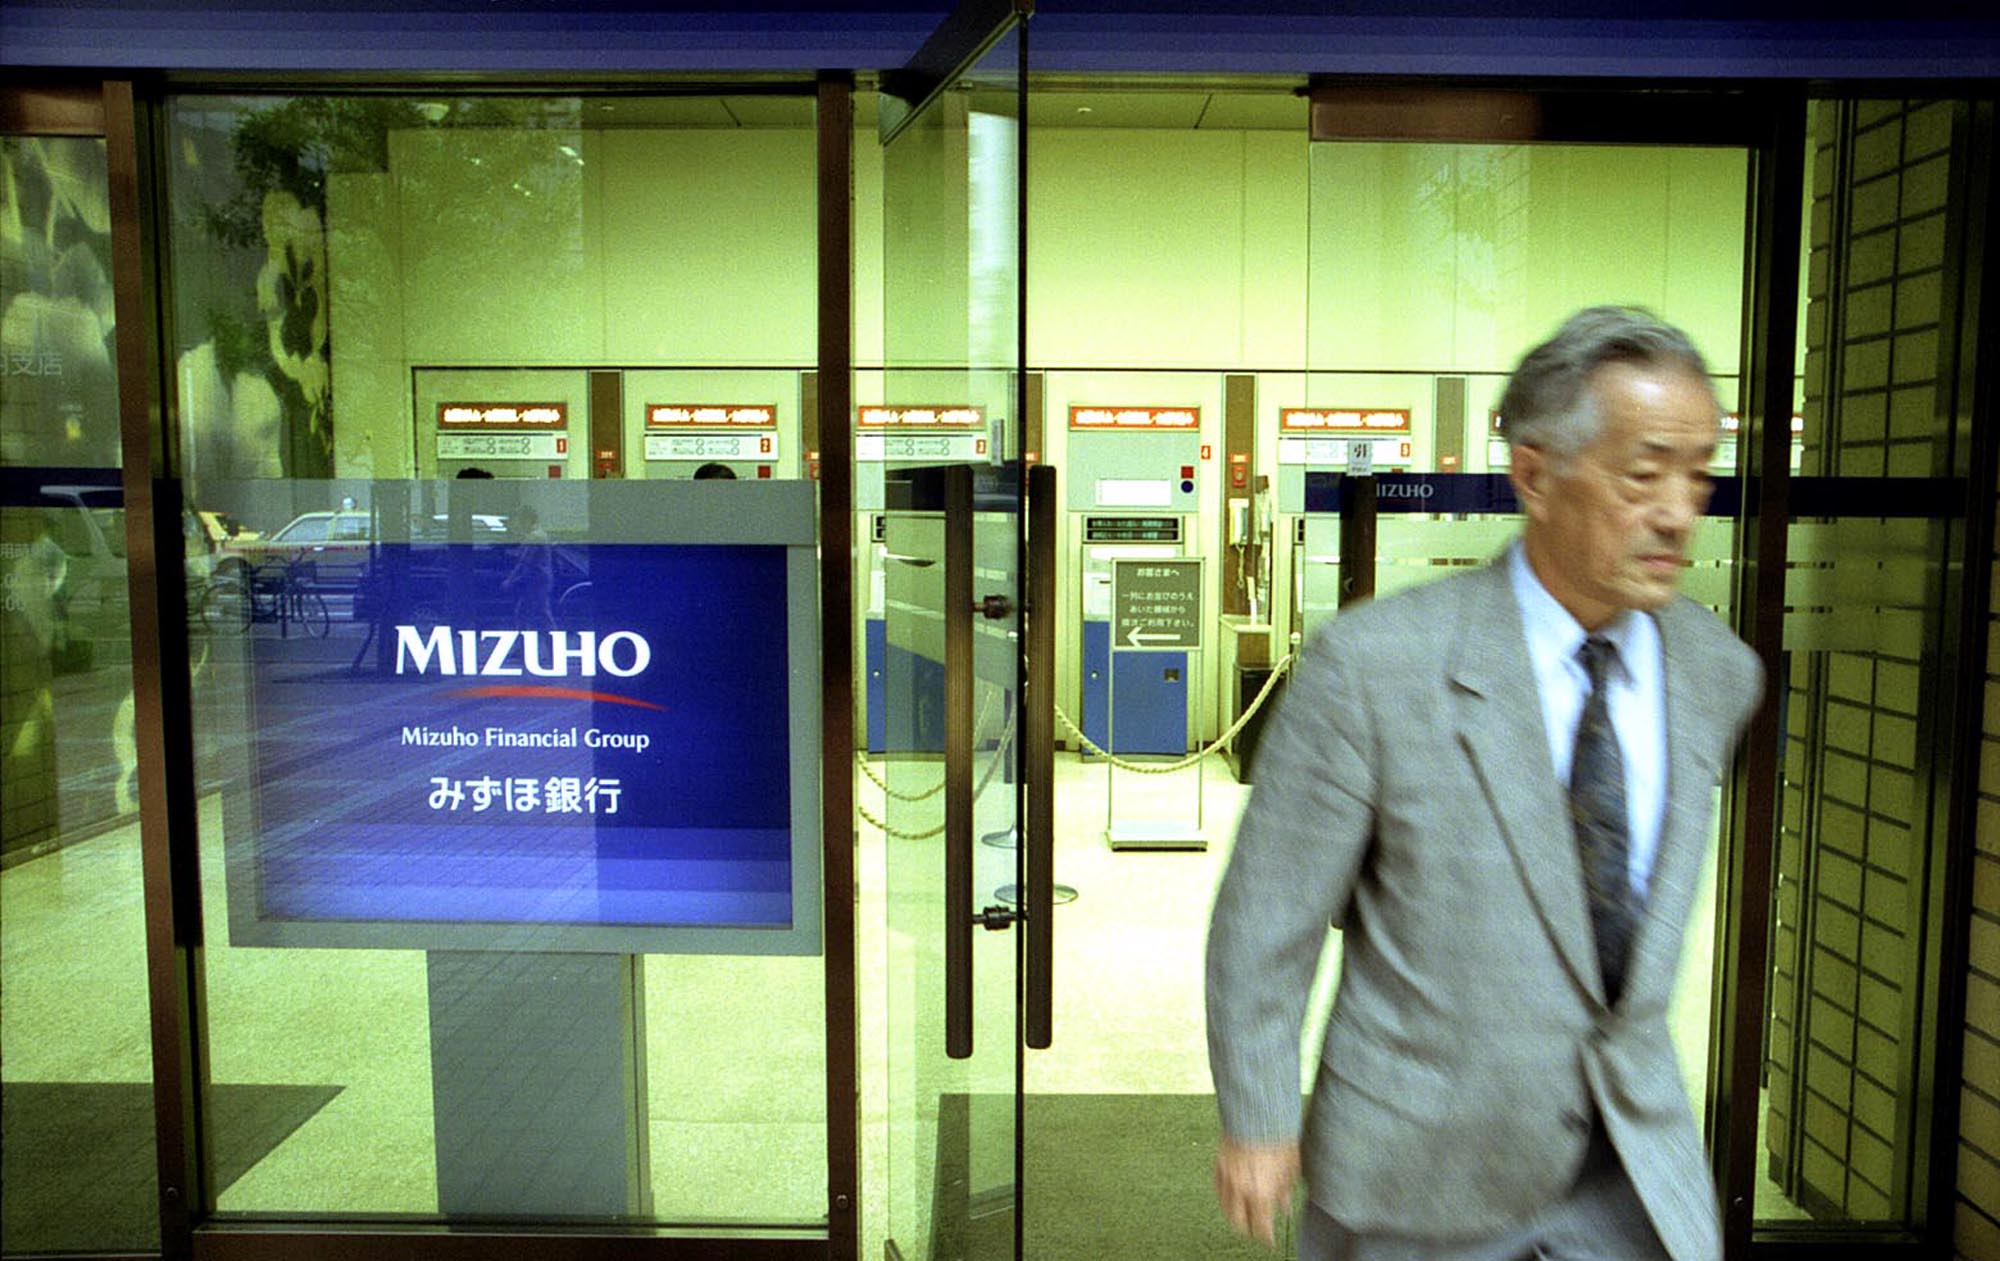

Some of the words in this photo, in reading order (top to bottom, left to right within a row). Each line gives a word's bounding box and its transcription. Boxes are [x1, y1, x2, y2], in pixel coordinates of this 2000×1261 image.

[395, 625, 651, 677] MIZUHO
[401, 727, 479, 747] Mizuho
[485, 728, 577, 748] Financial
[584, 729, 650, 753] Group
[428, 776, 622, 814] みずほ銀行
